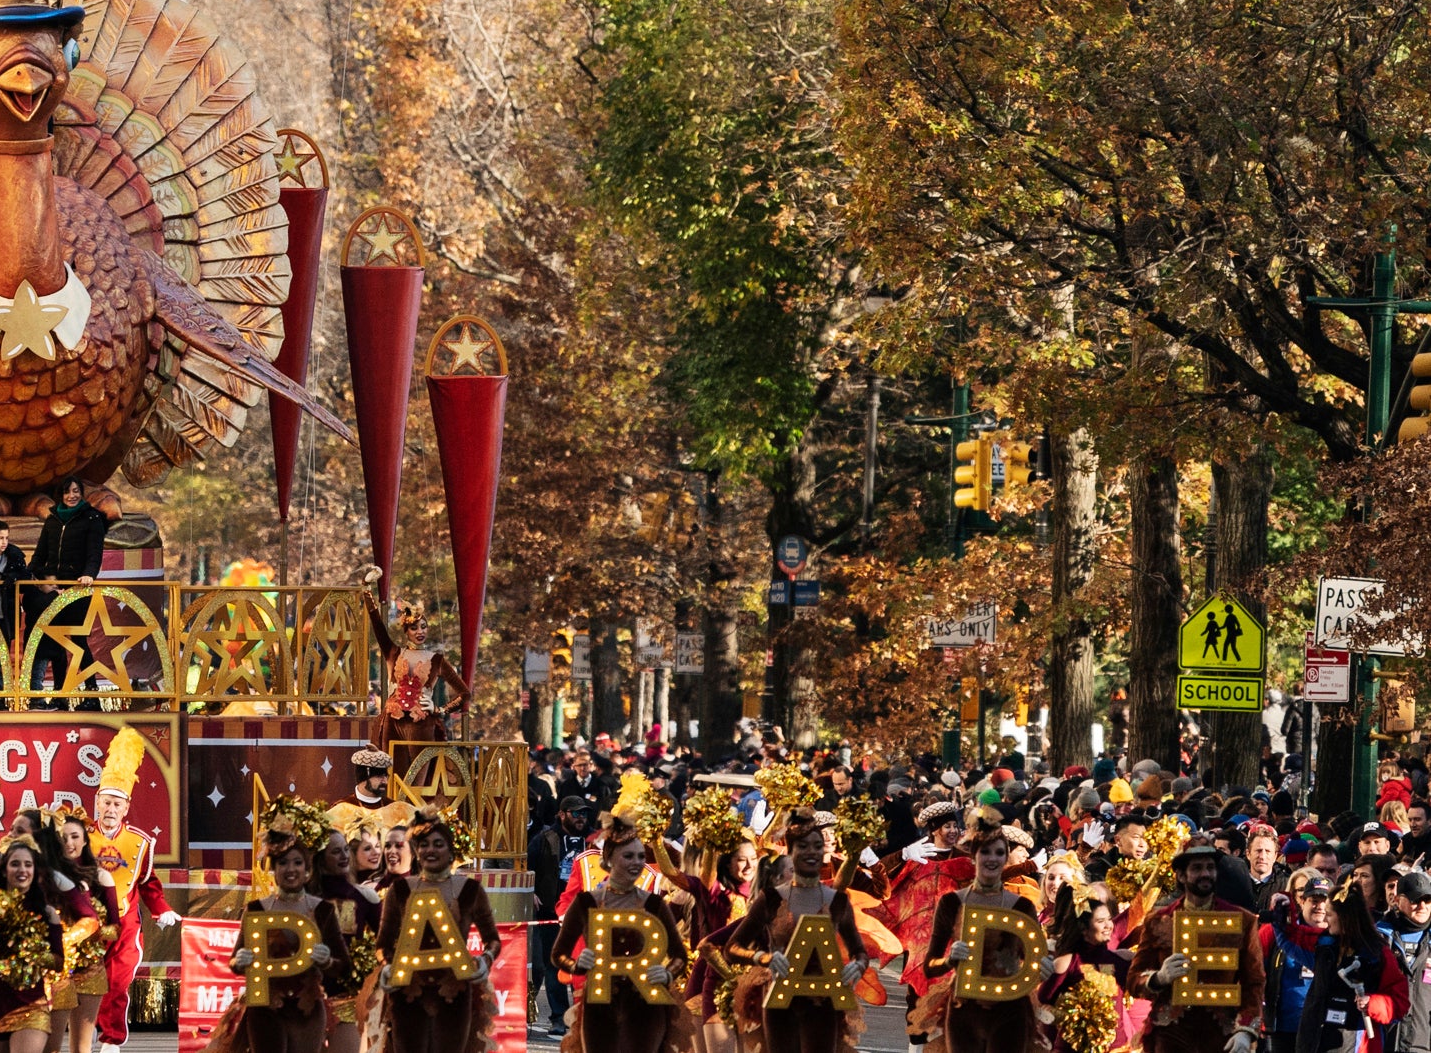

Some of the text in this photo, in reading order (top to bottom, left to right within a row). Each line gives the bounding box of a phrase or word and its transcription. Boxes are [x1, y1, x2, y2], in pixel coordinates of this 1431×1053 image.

[960, 621, 990, 637] ONLY
[1184, 684, 1255, 702] SCHOOL
[242, 909, 323, 1007] P
[390, 888, 480, 988] A
[587, 908, 676, 1005] R
[762, 914, 857, 1011] A
[955, 904, 1048, 1001] D
[1172, 910, 1244, 1007] E
